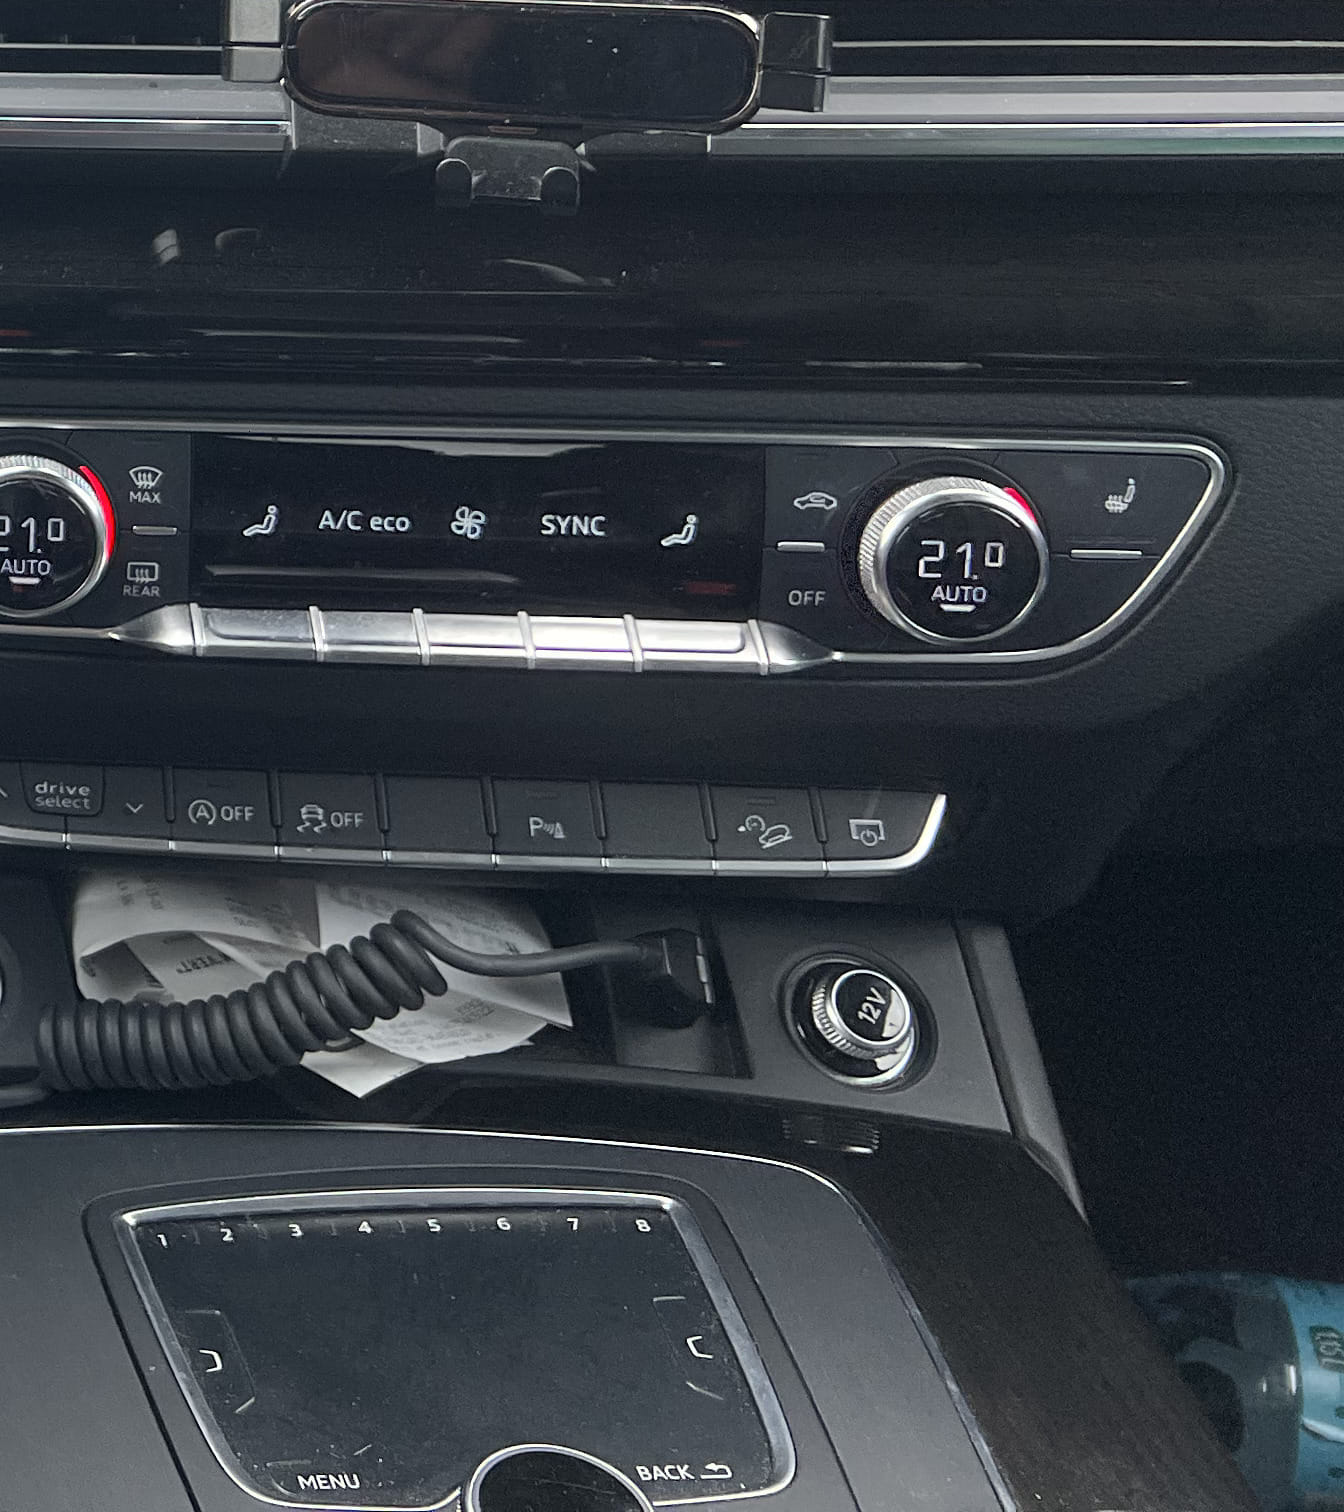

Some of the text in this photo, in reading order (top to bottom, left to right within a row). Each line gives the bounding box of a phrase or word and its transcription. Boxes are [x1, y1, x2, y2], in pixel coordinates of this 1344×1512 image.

[129, 491, 162, 505] MAX
[318, 510, 411, 533] A/C eco
[541, 515, 606, 536] SYNC
[0, 559, 52, 577] AUTO
[123, 584, 160, 598] REAR
[788, 590, 826, 607] OFF
[930, 585, 987, 603] AUTO
[35, 781, 91, 796] drive
[35, 795, 91, 810] select
[220, 805, 254, 822] OFF
[330, 812, 364, 828] OFF
[857, 987, 886, 1024] 12V
[157, 1217, 651, 1247] 1 2 3 4 5 6 7 8
[636, 1463, 692, 1482] BACK
[297, 1473, 361, 1491] MENU
